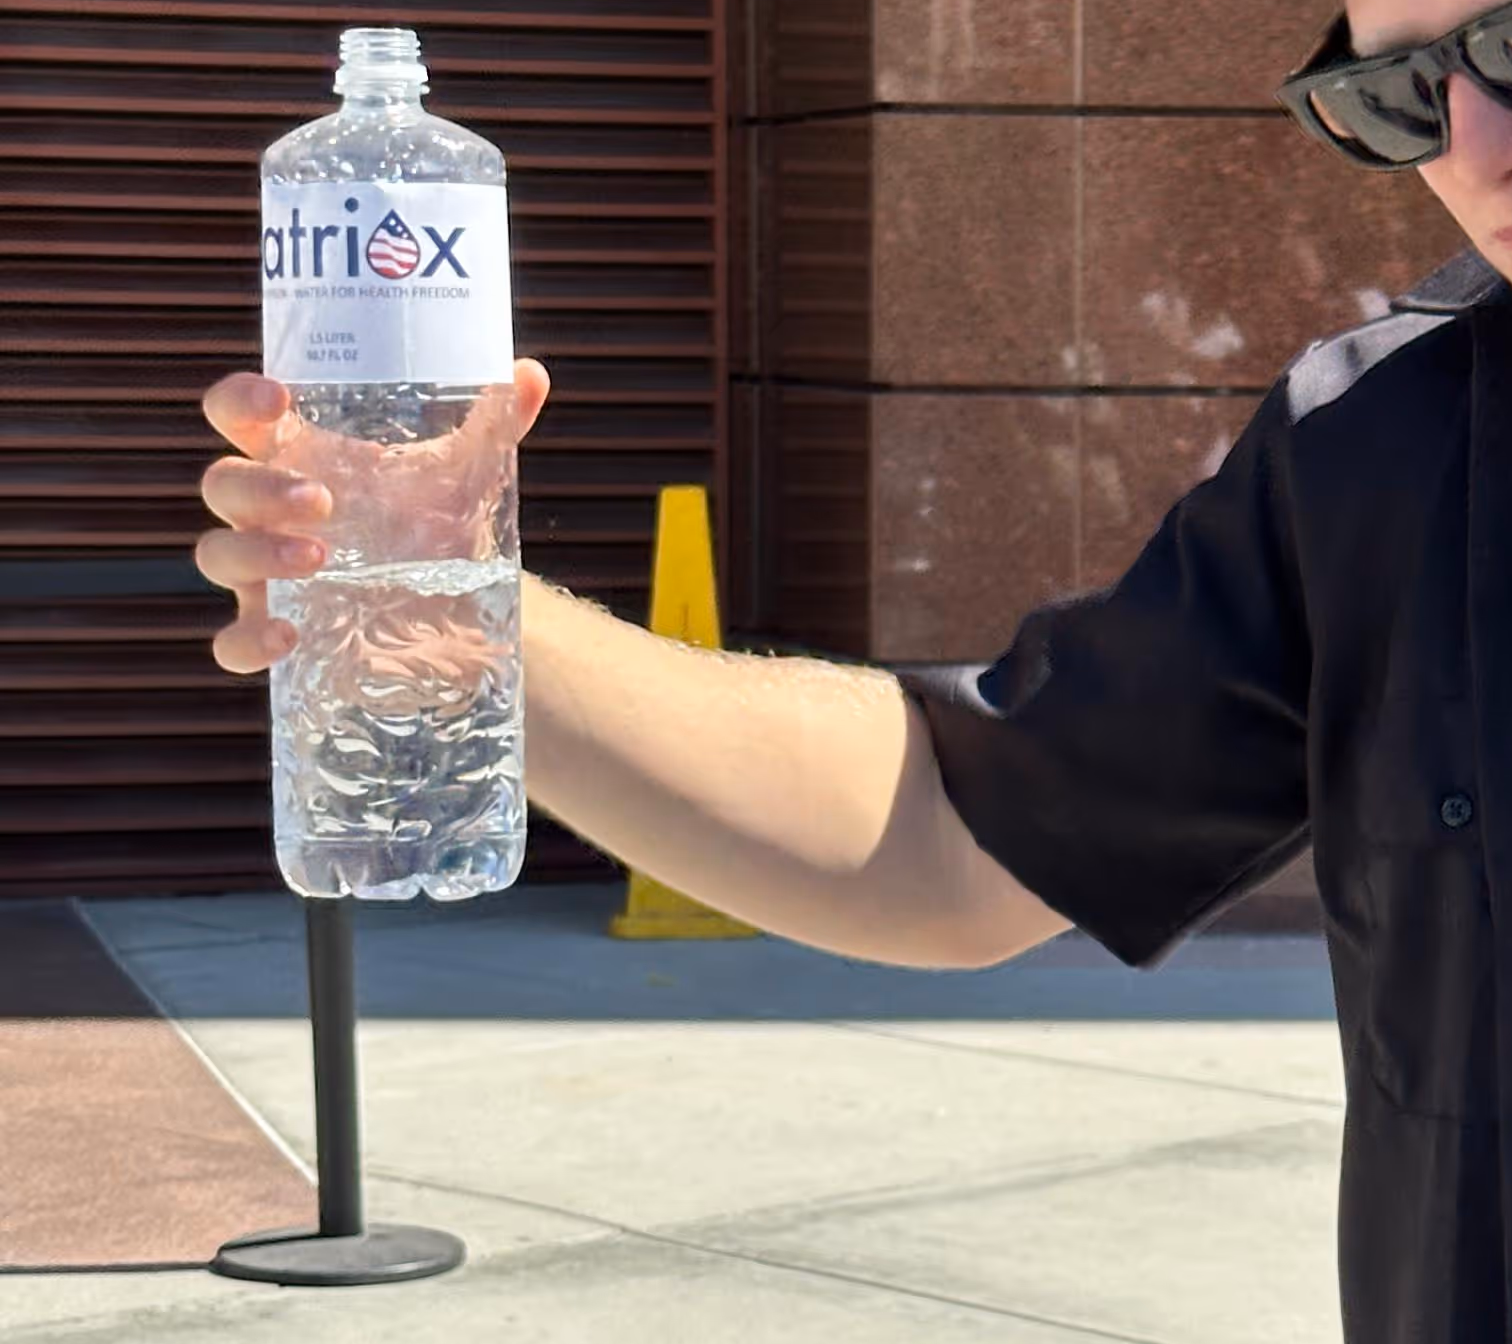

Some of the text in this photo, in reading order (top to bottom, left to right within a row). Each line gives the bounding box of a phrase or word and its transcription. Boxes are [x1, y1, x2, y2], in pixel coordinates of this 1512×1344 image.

[332, 286, 355, 299] FOR
[358, 286, 409, 299] HEALTH
[412, 286, 470, 299] FREEDOM
